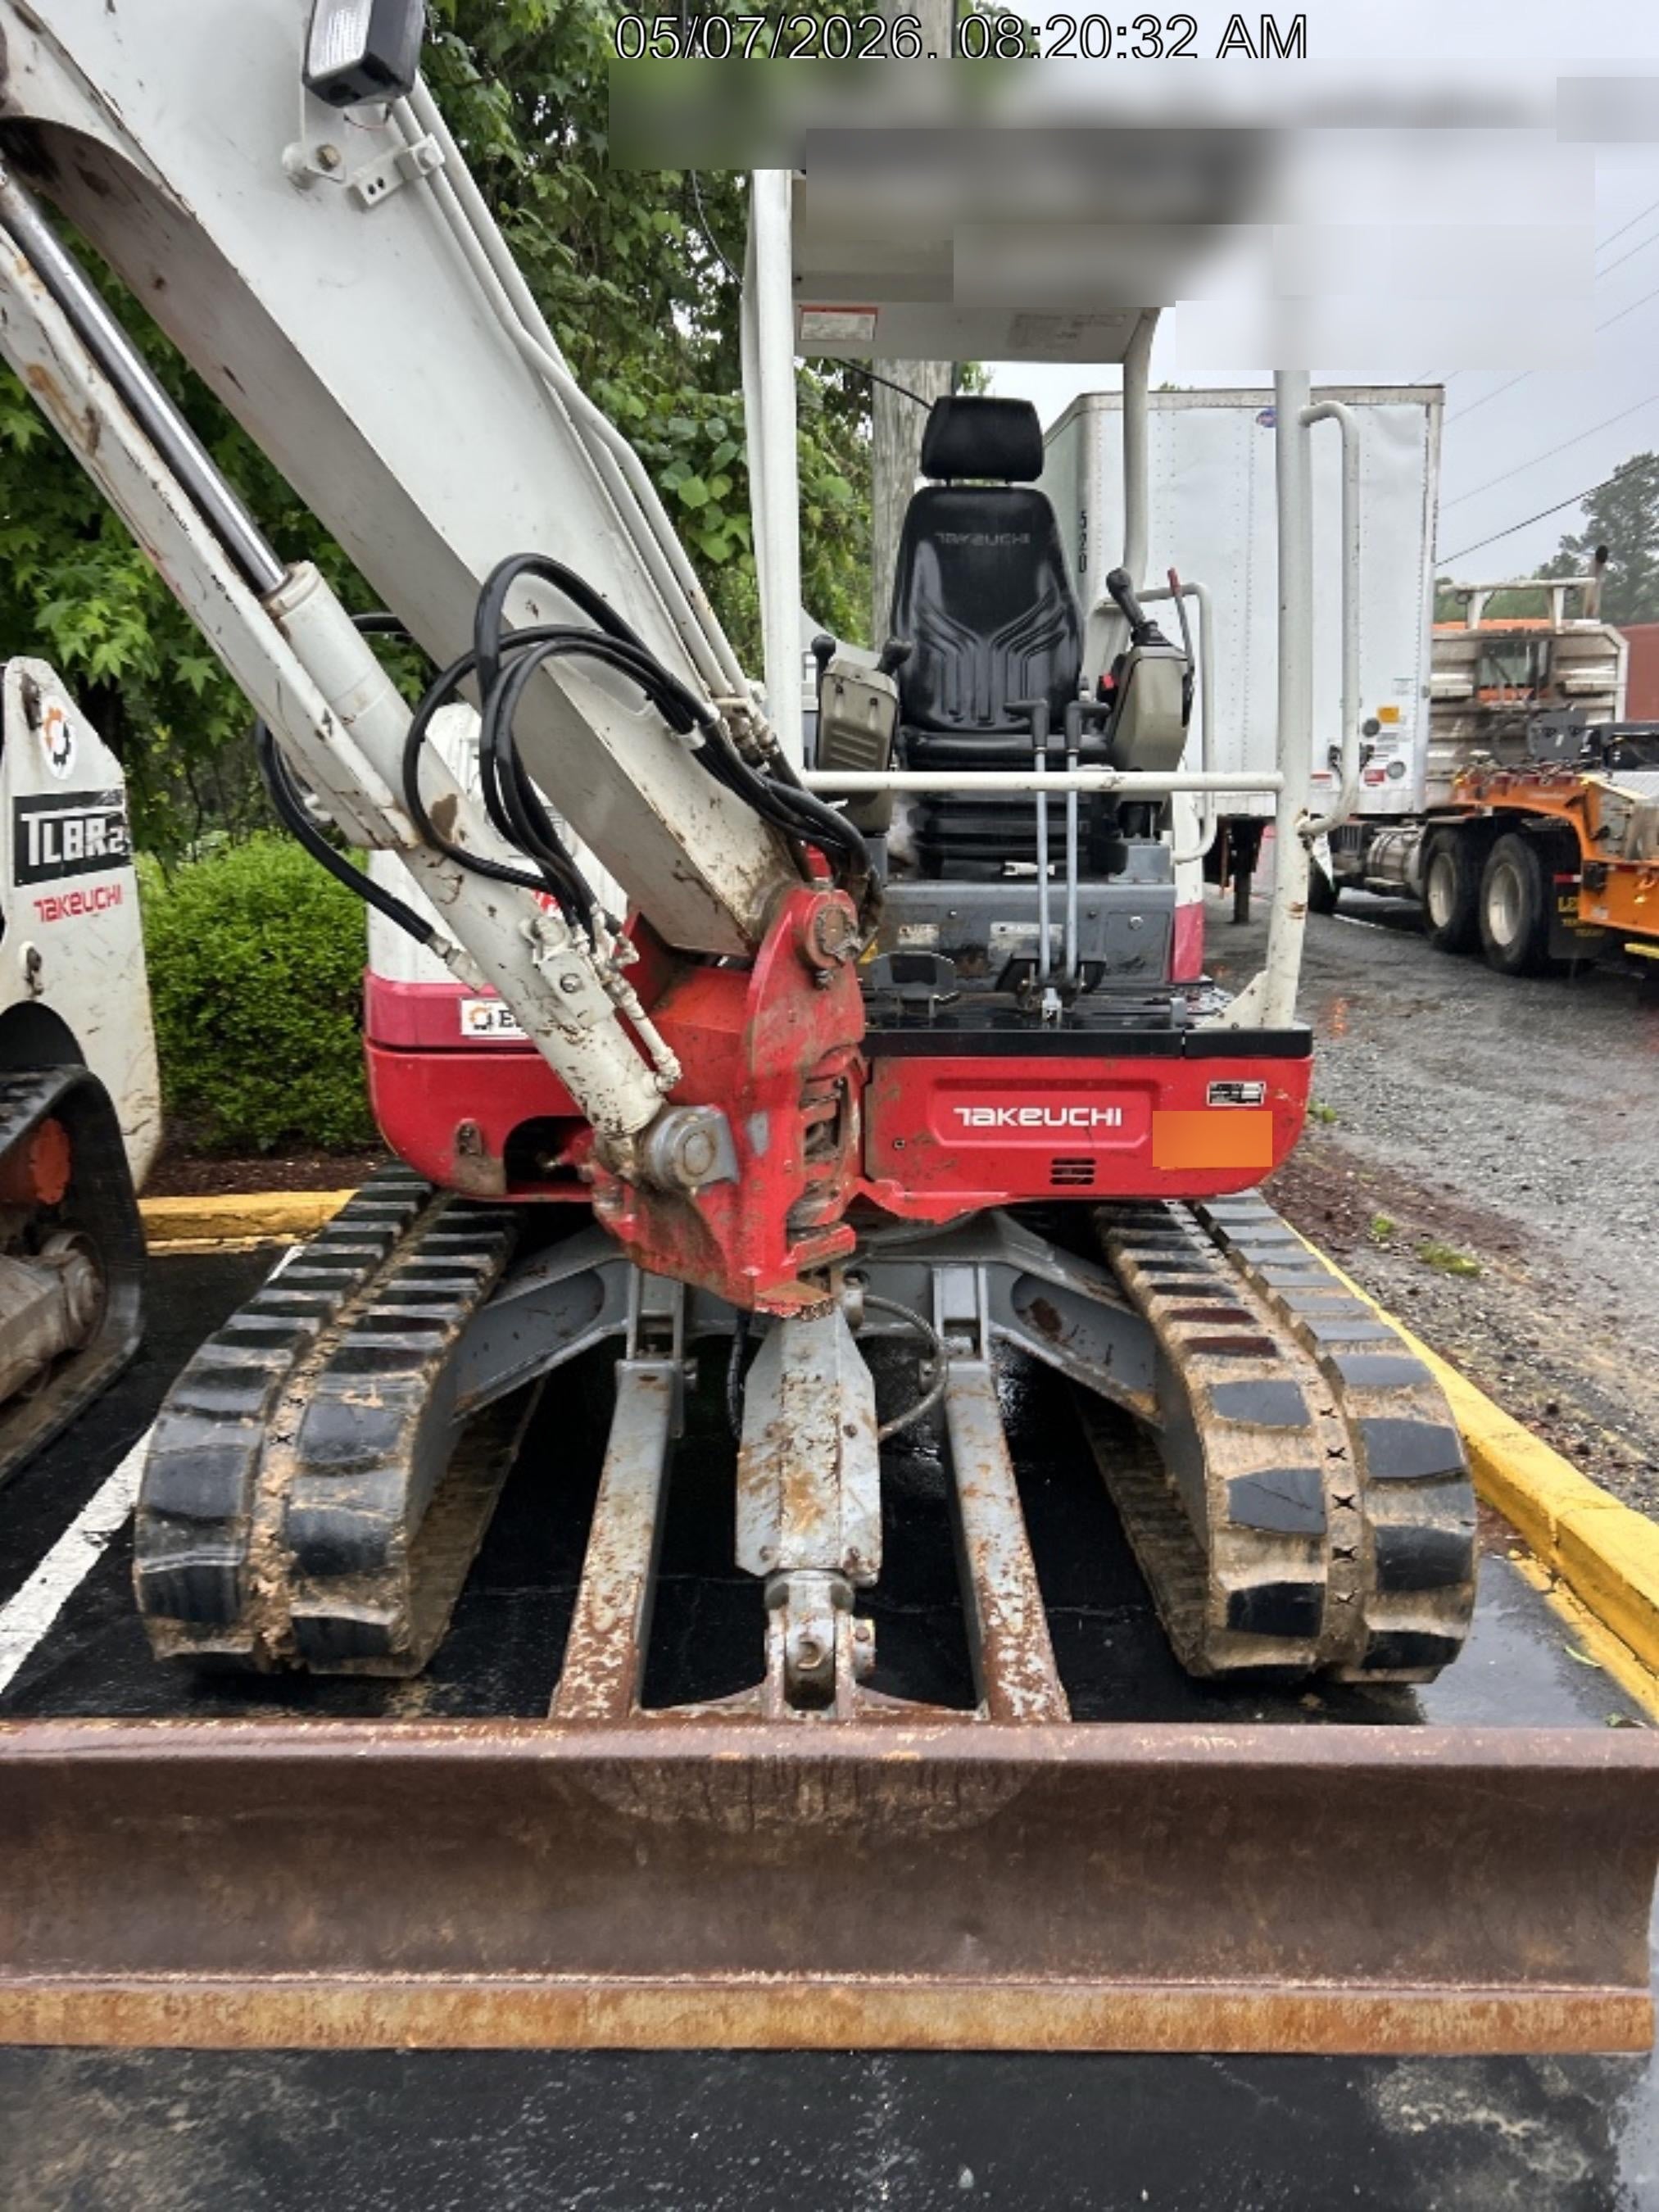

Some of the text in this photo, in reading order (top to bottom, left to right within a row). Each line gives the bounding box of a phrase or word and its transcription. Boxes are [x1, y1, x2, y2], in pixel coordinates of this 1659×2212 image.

[933, 532, 1031, 546] TAKEUCHI
[33, 883, 123, 922] TAKEUCHI
[953, 1107, 1122, 1127] TAKEUCHI
